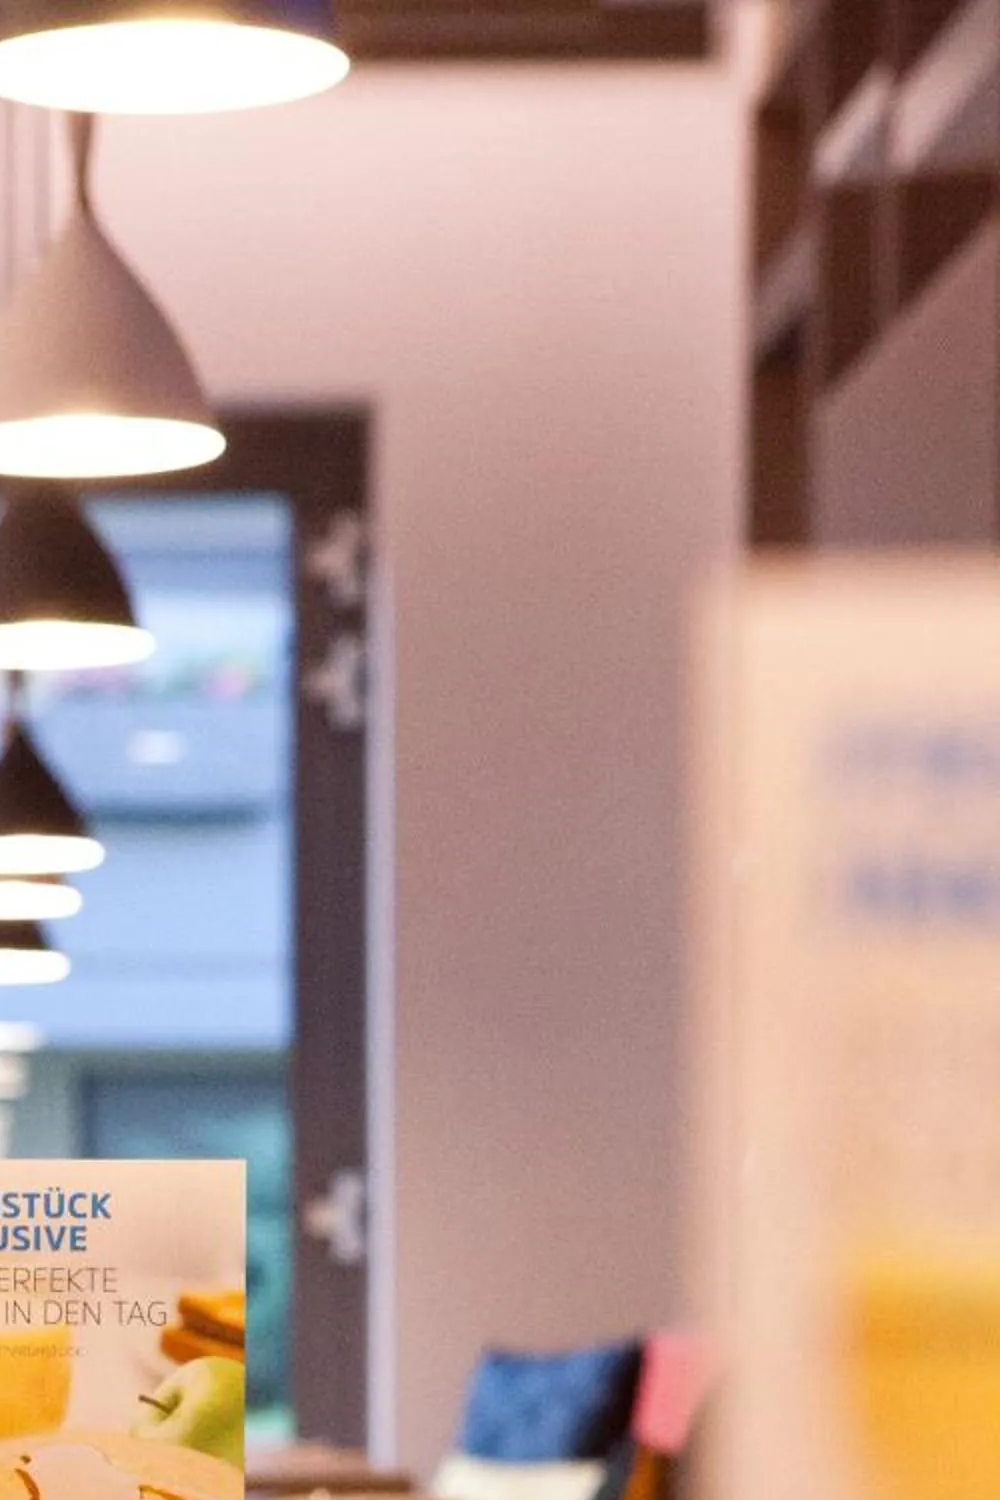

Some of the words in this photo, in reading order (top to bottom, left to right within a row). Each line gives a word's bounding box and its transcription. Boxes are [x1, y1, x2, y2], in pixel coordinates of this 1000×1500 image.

[5, 1299, 31, 1325] IN
[43, 1299, 101, 1326] DEN
[112, 1300, 168, 1327] TAG
